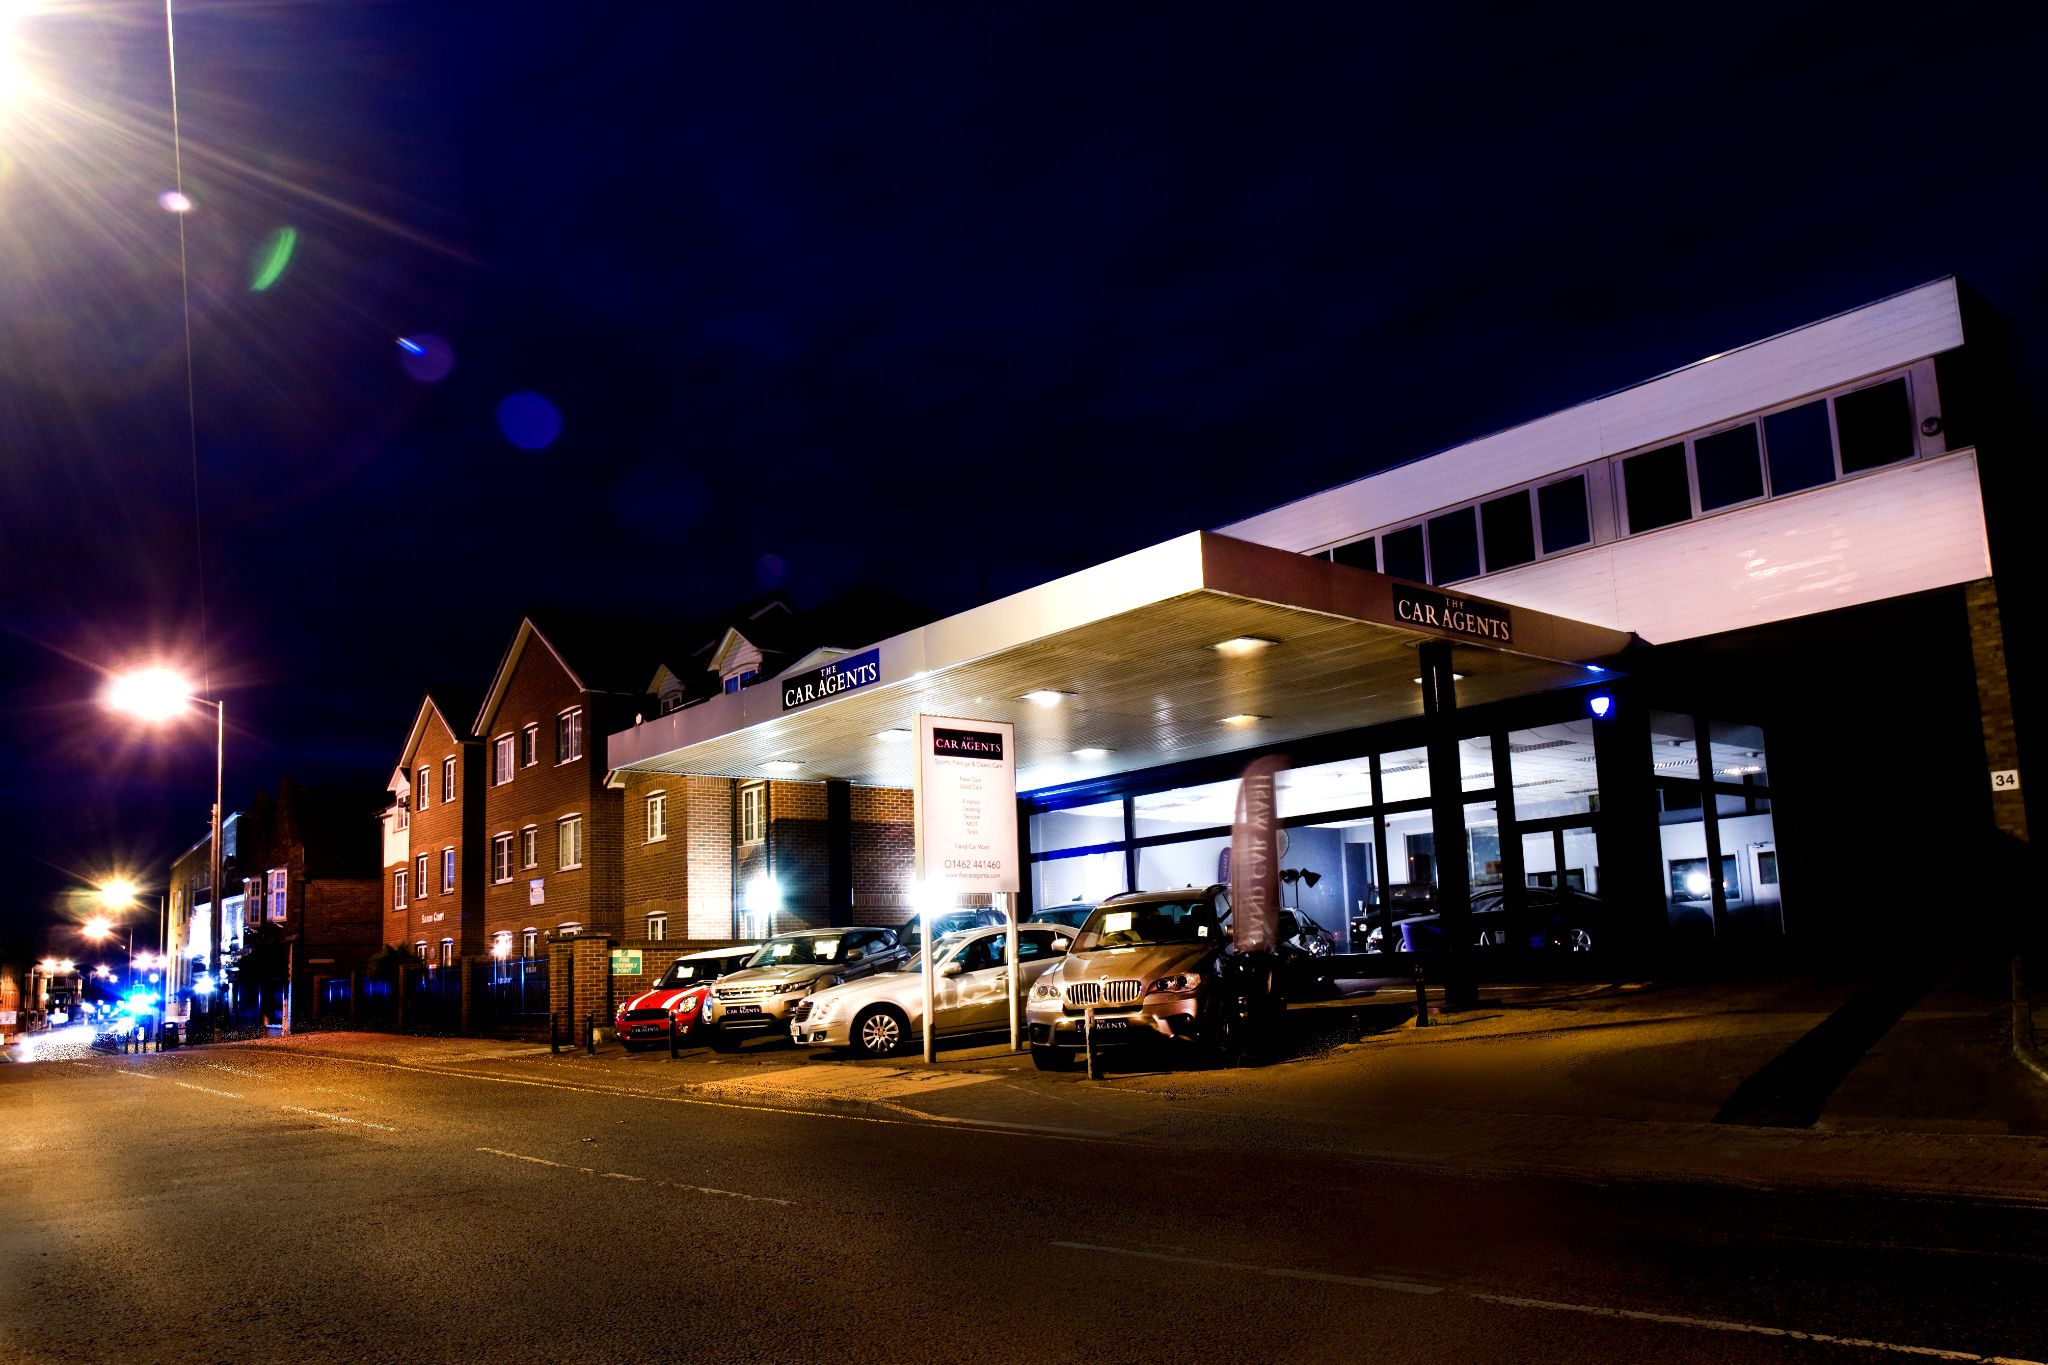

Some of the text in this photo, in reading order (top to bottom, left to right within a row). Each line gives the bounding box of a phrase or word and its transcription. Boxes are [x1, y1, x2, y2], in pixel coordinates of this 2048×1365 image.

[1445, 597, 1464, 610] THE
[1398, 599, 1509, 640] CAR AGENTS
[820, 664, 837, 677] THE
[785, 662, 877, 707] CAR AGENTS
[935, 738, 1001, 753] CAR AGENTS
[1995, 773, 2016, 787] 34
[944, 859, 1001, 870] 01462 441460
[1096, 1021, 1127, 1029] AGENTS
